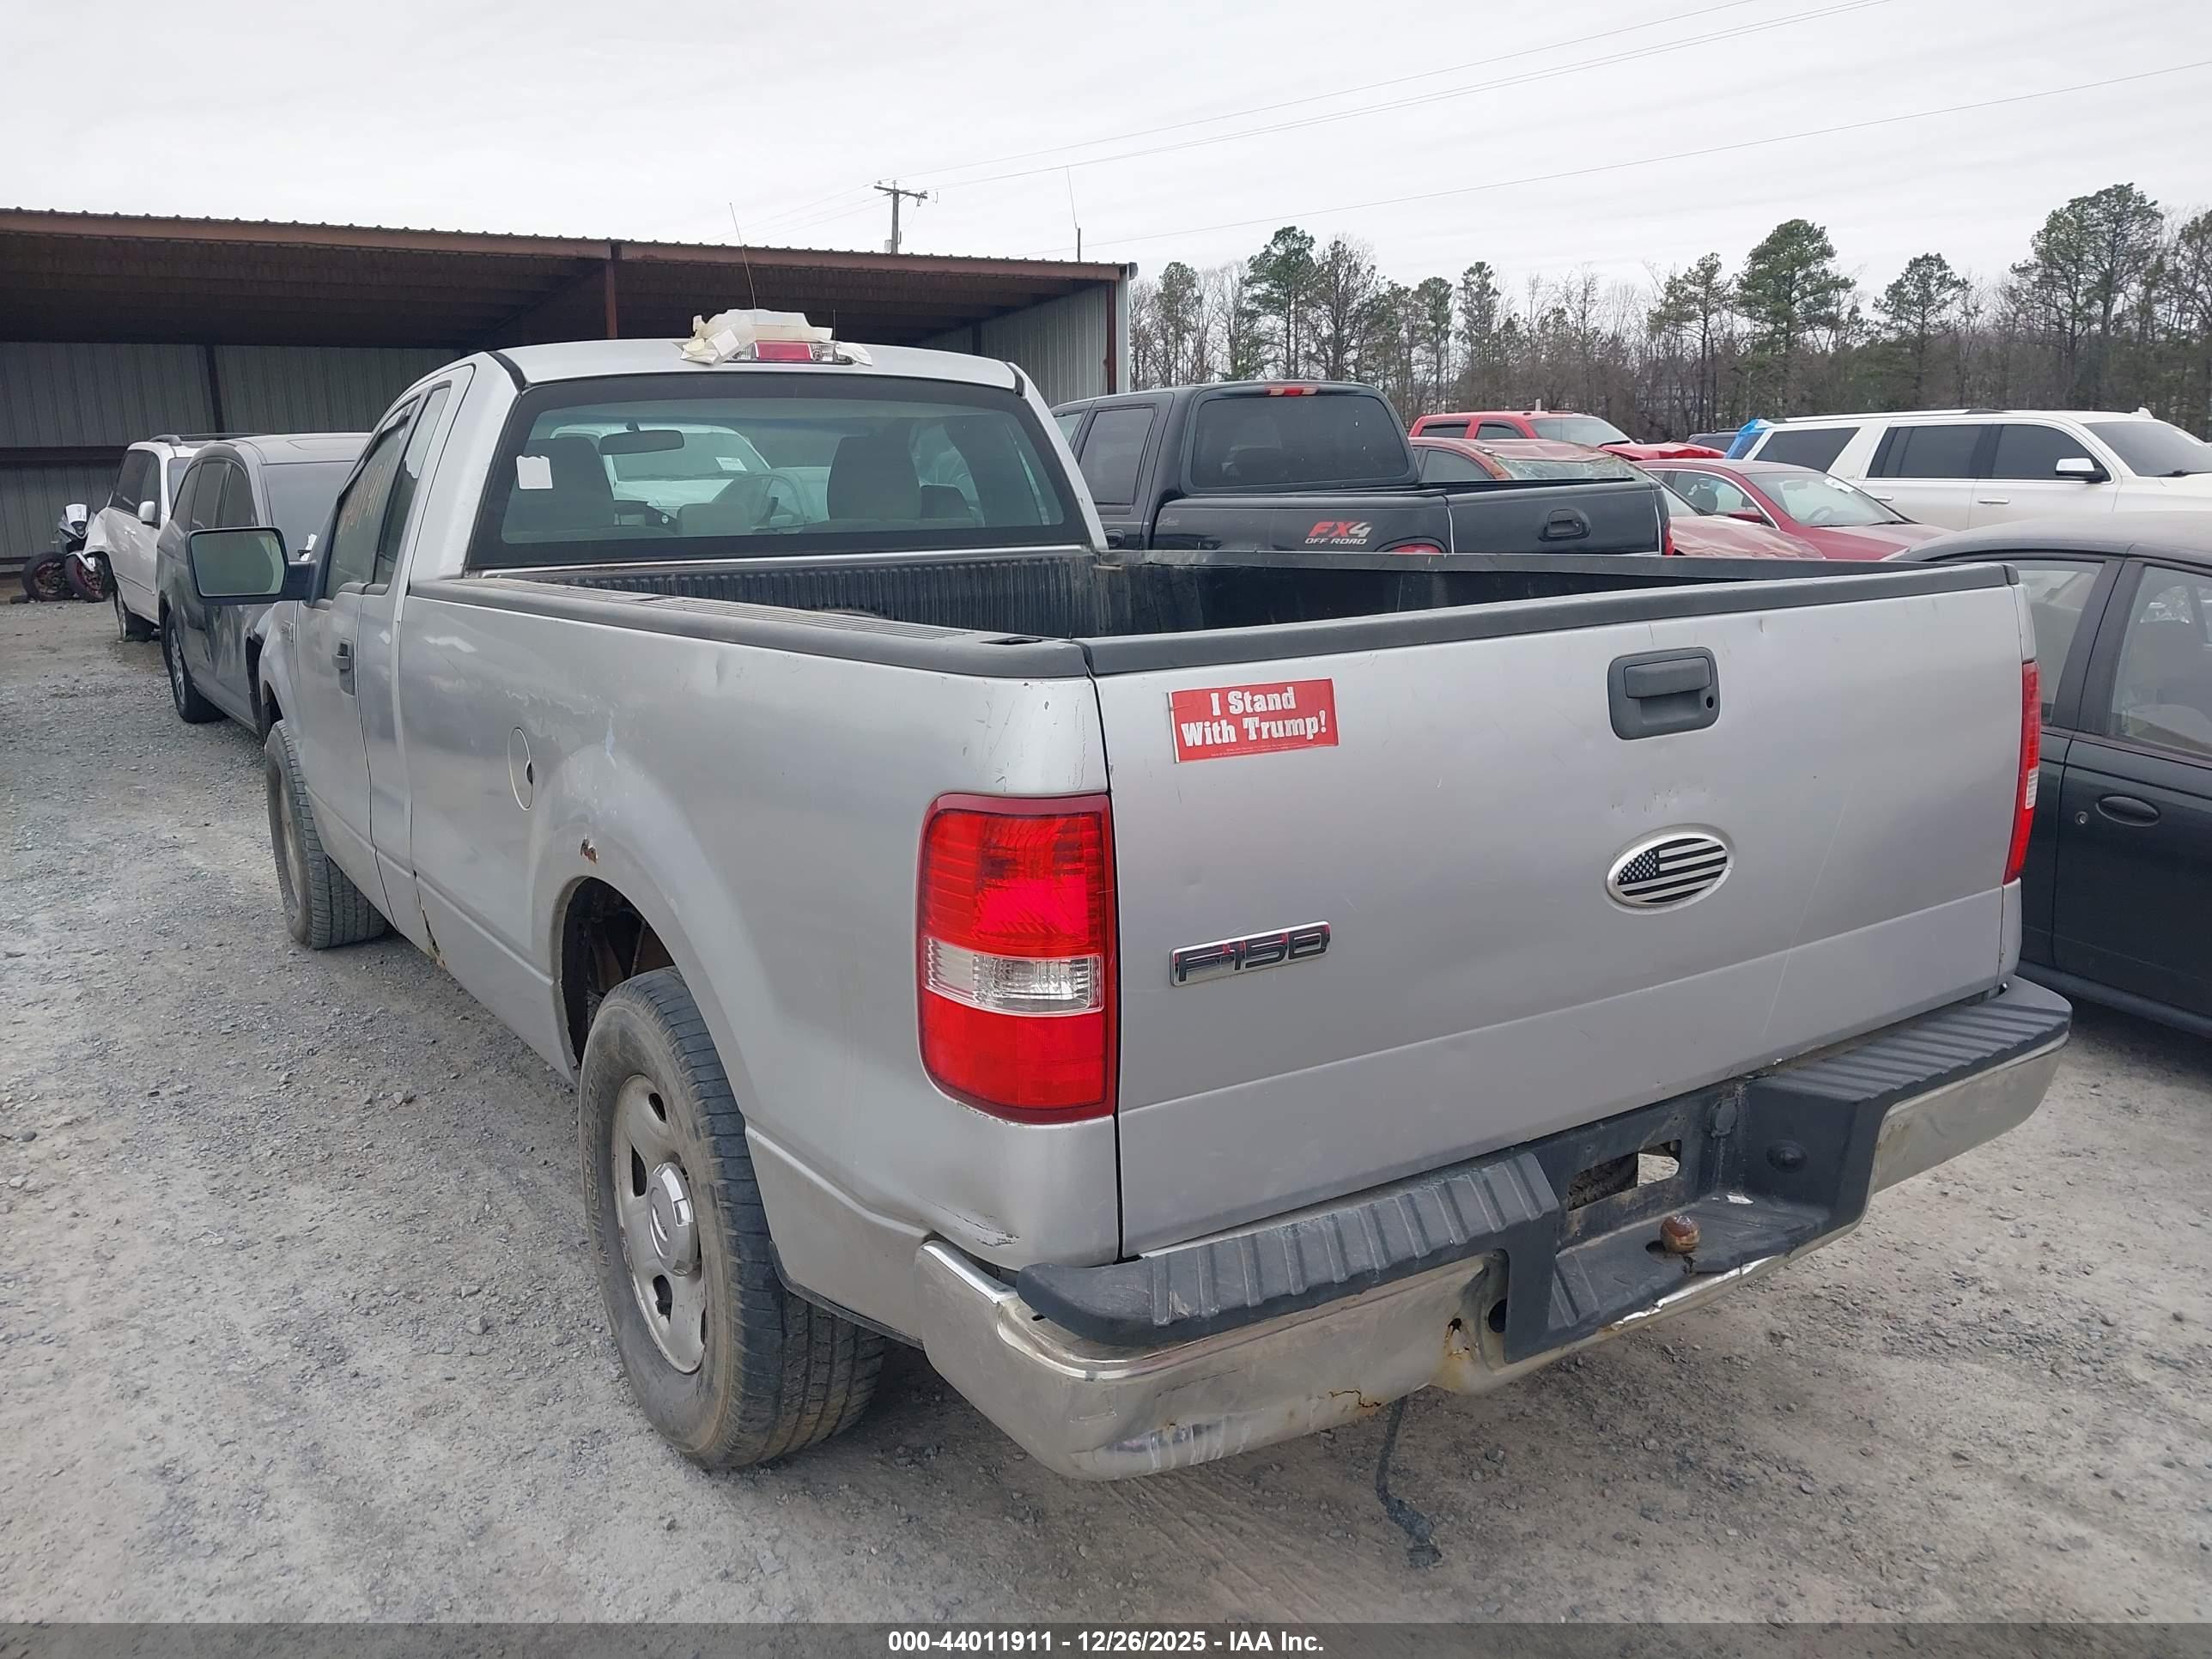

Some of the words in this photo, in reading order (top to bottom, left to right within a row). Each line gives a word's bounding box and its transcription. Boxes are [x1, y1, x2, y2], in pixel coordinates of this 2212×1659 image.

[1308, 521, 1372, 538] FX4
[1210, 692, 1221, 716] I
[1227, 686, 1297, 715] Stand
[1181, 720, 1237, 747] With
[1243, 709, 1327, 740] Trump!
[1173, 923, 1330, 983] F150
